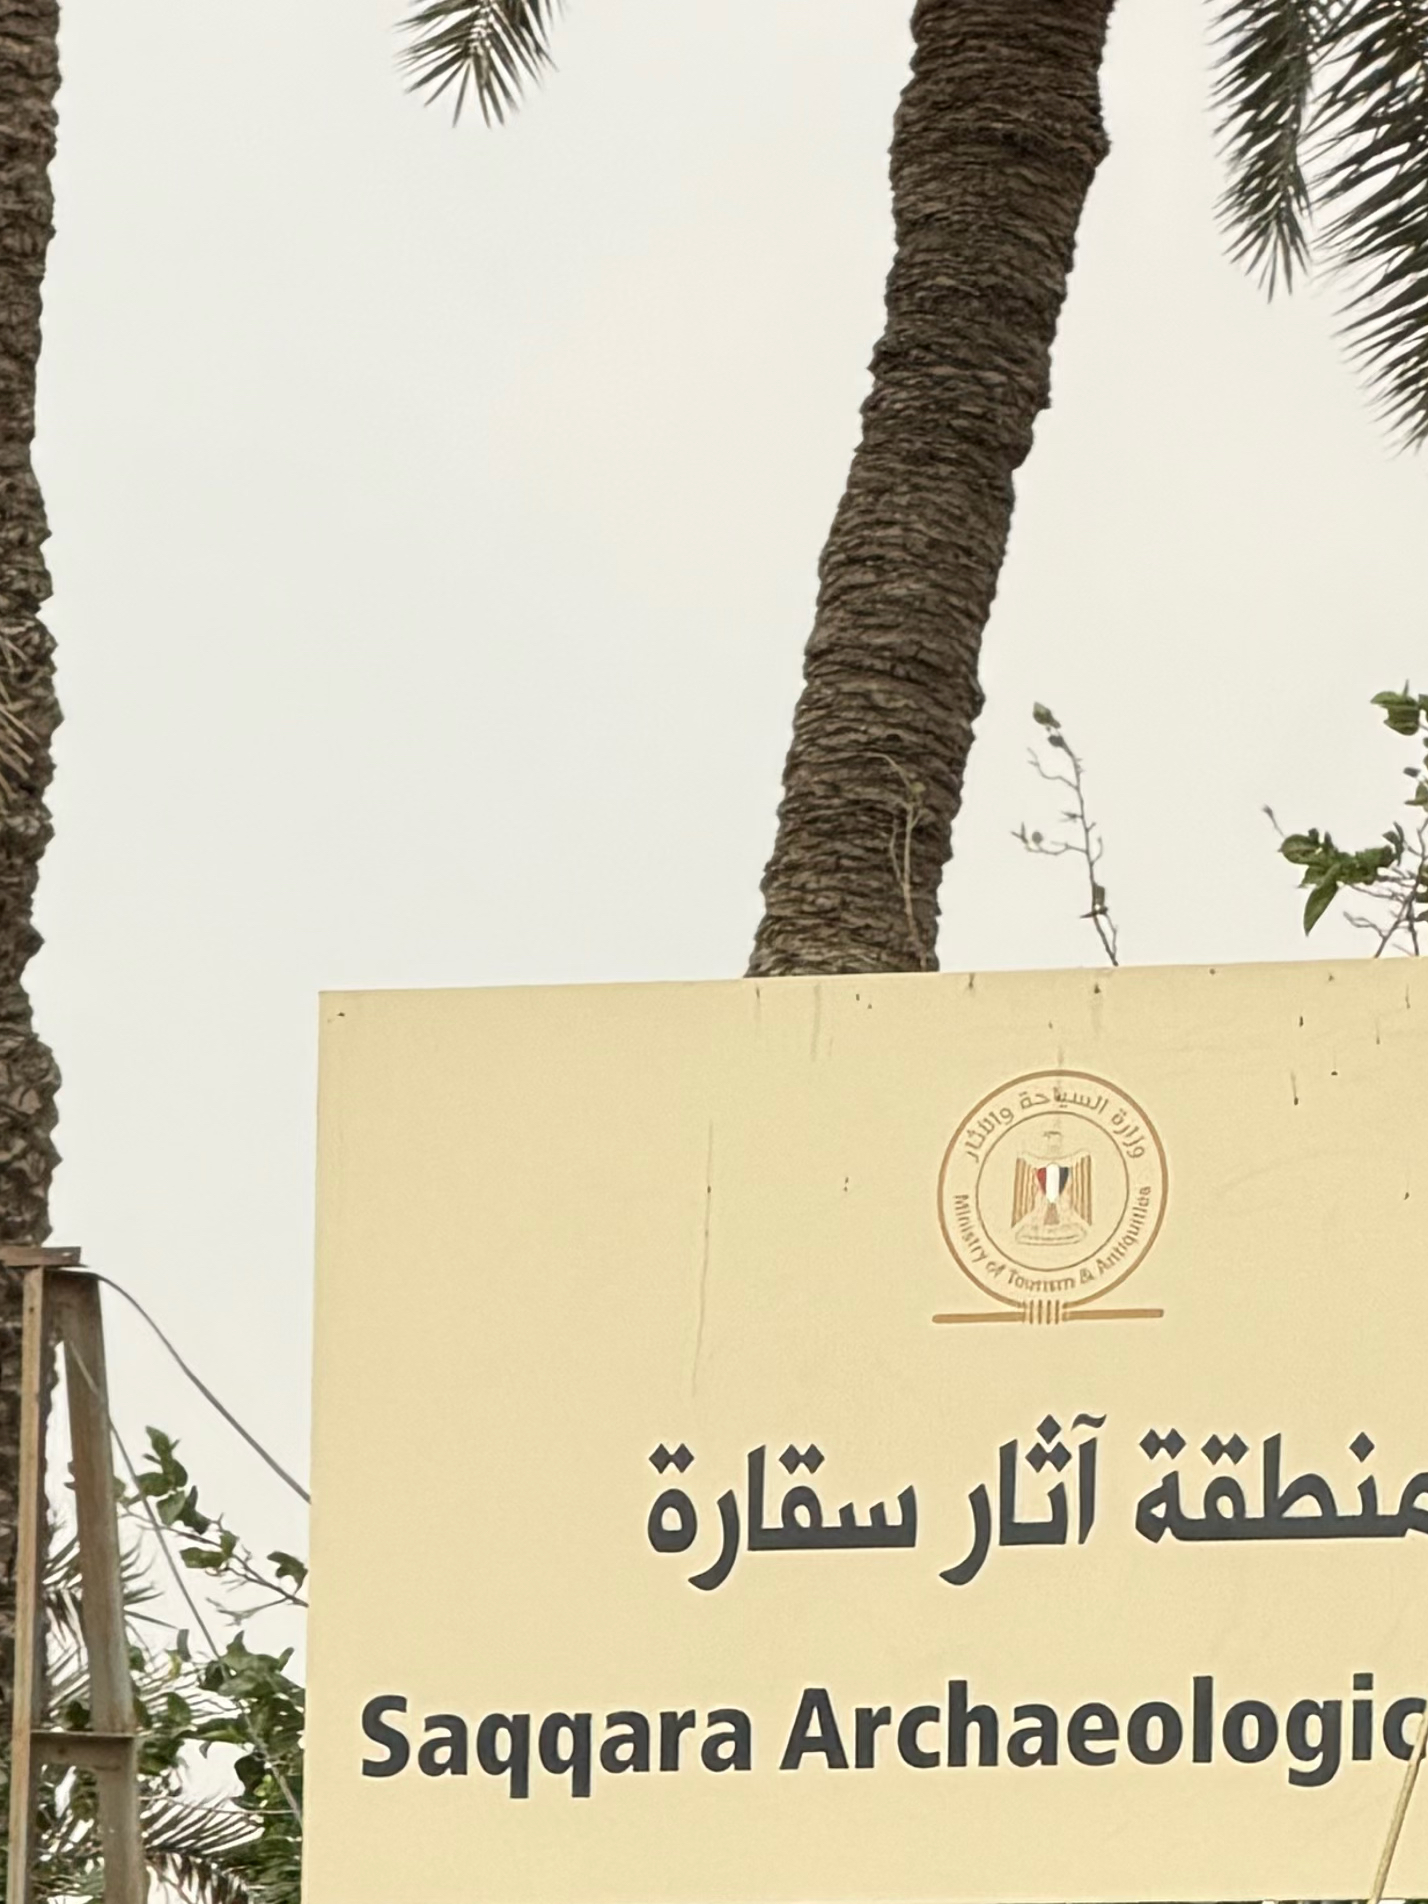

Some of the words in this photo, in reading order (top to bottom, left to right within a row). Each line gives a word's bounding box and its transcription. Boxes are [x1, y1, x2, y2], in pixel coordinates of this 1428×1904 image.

[1019, 1087, 1109, 1114] السياحة
[1112, 1109, 1145, 1159] وزارة
[953, 1193, 988, 1262] Ministry
[984, 1259, 1006, 1278] of
[1008, 1268, 1076, 1293] Tourism
[1079, 1268, 1096, 1285] &
[1097, 1186, 1151, 1275] Antiquities
[647, 1443, 917, 1591] سقارة
[939, 1414, 1106, 1586] آثار
[362, 1695, 752, 1799] Saqqara
